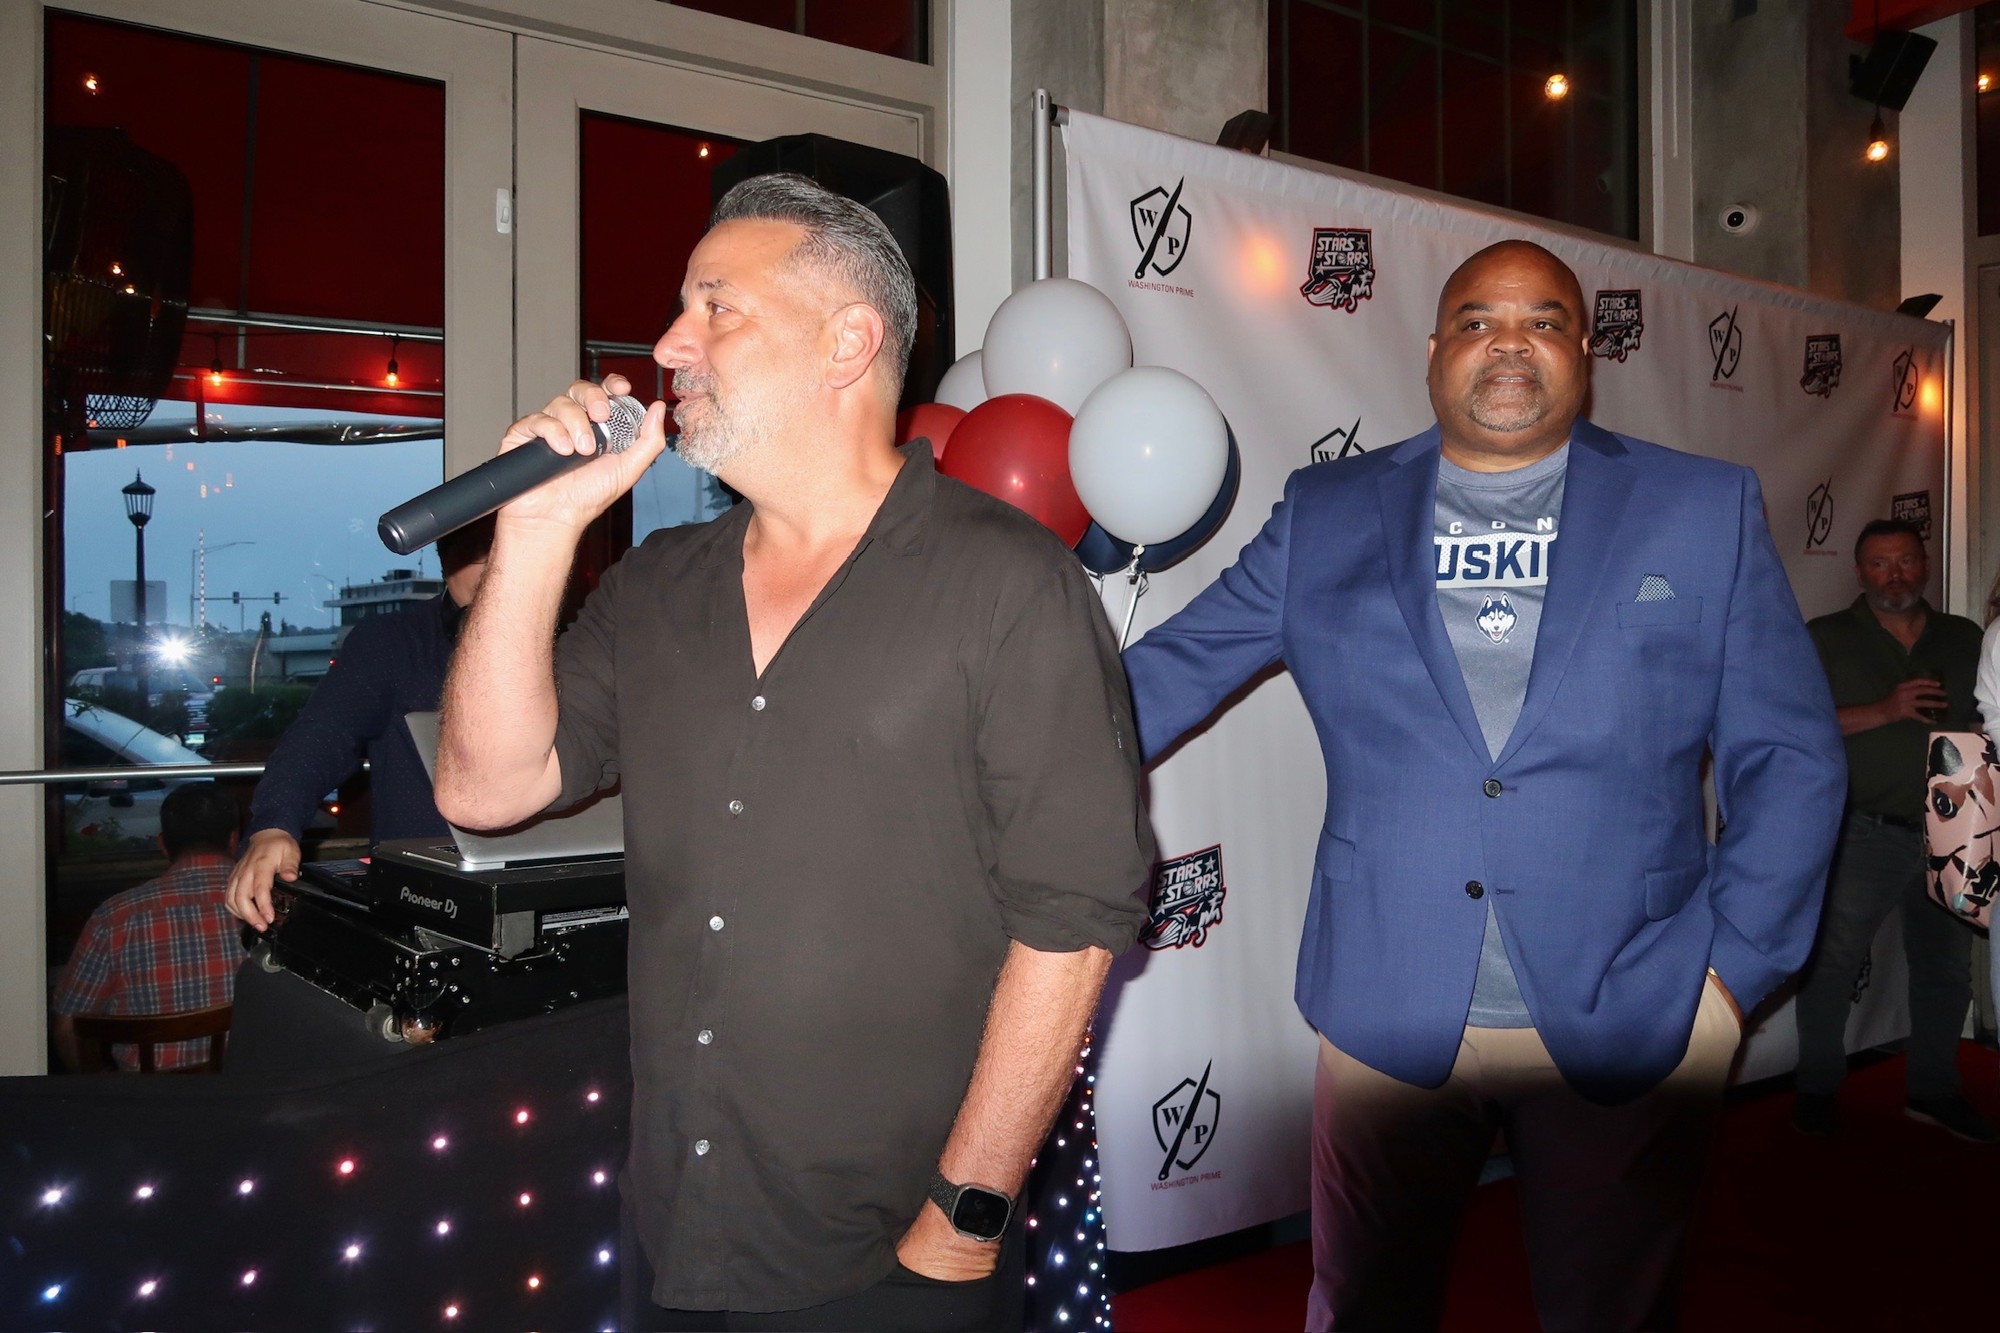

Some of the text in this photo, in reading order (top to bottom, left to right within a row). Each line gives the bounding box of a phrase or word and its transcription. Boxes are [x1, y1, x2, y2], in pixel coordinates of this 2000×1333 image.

[1138, 207, 1159, 229] W
[1167, 236, 1180, 256] P
[1317, 236, 1355, 251] STARS
[1128, 279, 1195, 298] WASHINGTON PRIME
[1598, 297, 1628, 310] STARS
[1434, 540, 1551, 581] USKI
[1158, 860, 1204, 888] STARS
[400, 886, 443, 910] Pioneer
[1161, 1105, 1185, 1127] W
[1193, 1124, 1209, 1145] P
[1150, 1170, 1222, 1191] WASHINGTON PRIME
